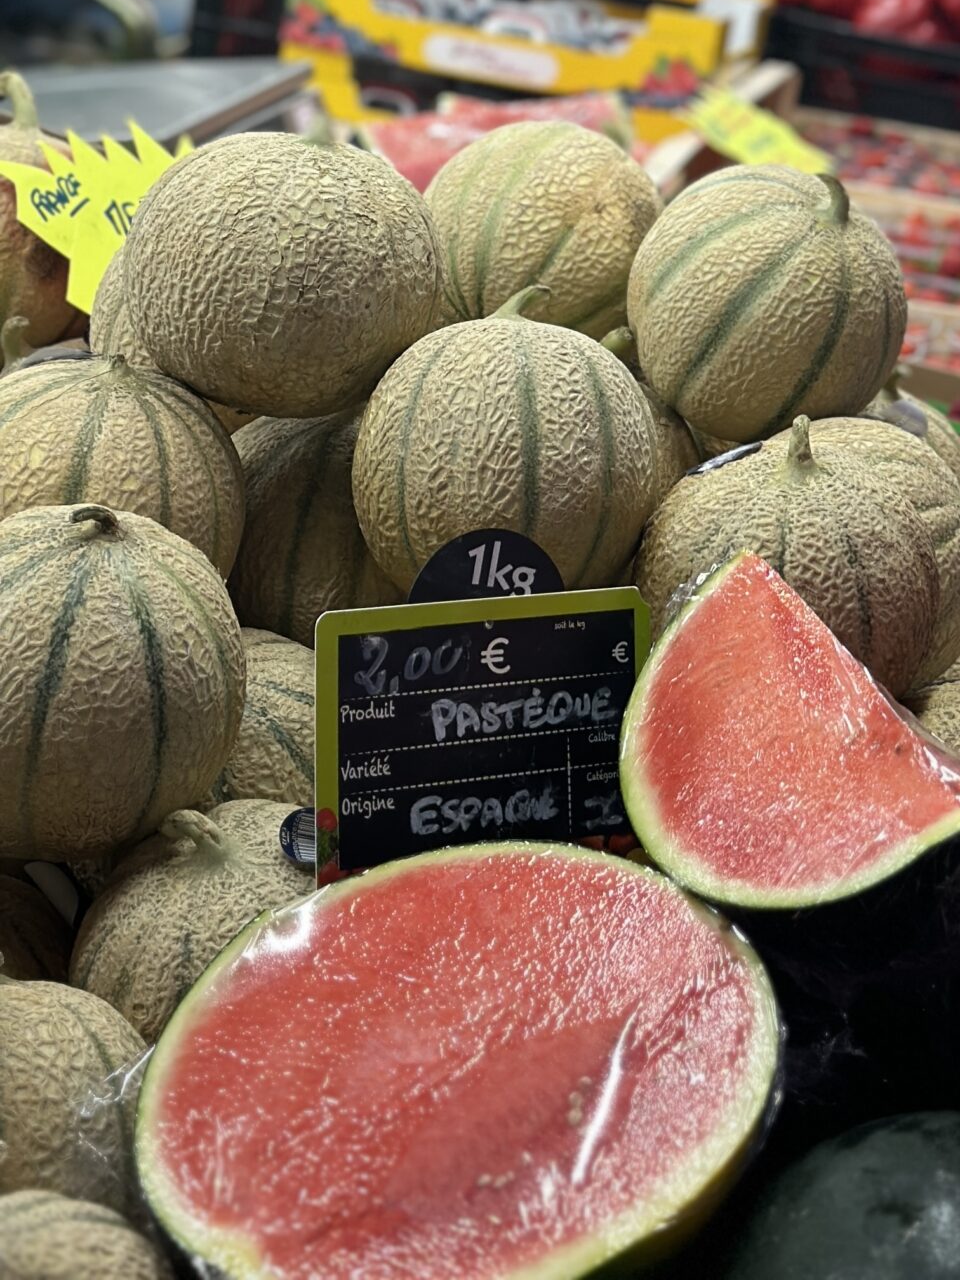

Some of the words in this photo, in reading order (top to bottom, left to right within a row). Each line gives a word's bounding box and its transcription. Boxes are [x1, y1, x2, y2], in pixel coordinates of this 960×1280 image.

[467, 541, 536, 597] 1kg
[480, 637, 511, 675] €
[612, 641, 630, 664] €
[340, 700, 396, 724] Produit
[588, 730, 616, 744] Calibre
[341, 755, 392, 781] Variété
[341, 794, 396, 819] Origine
